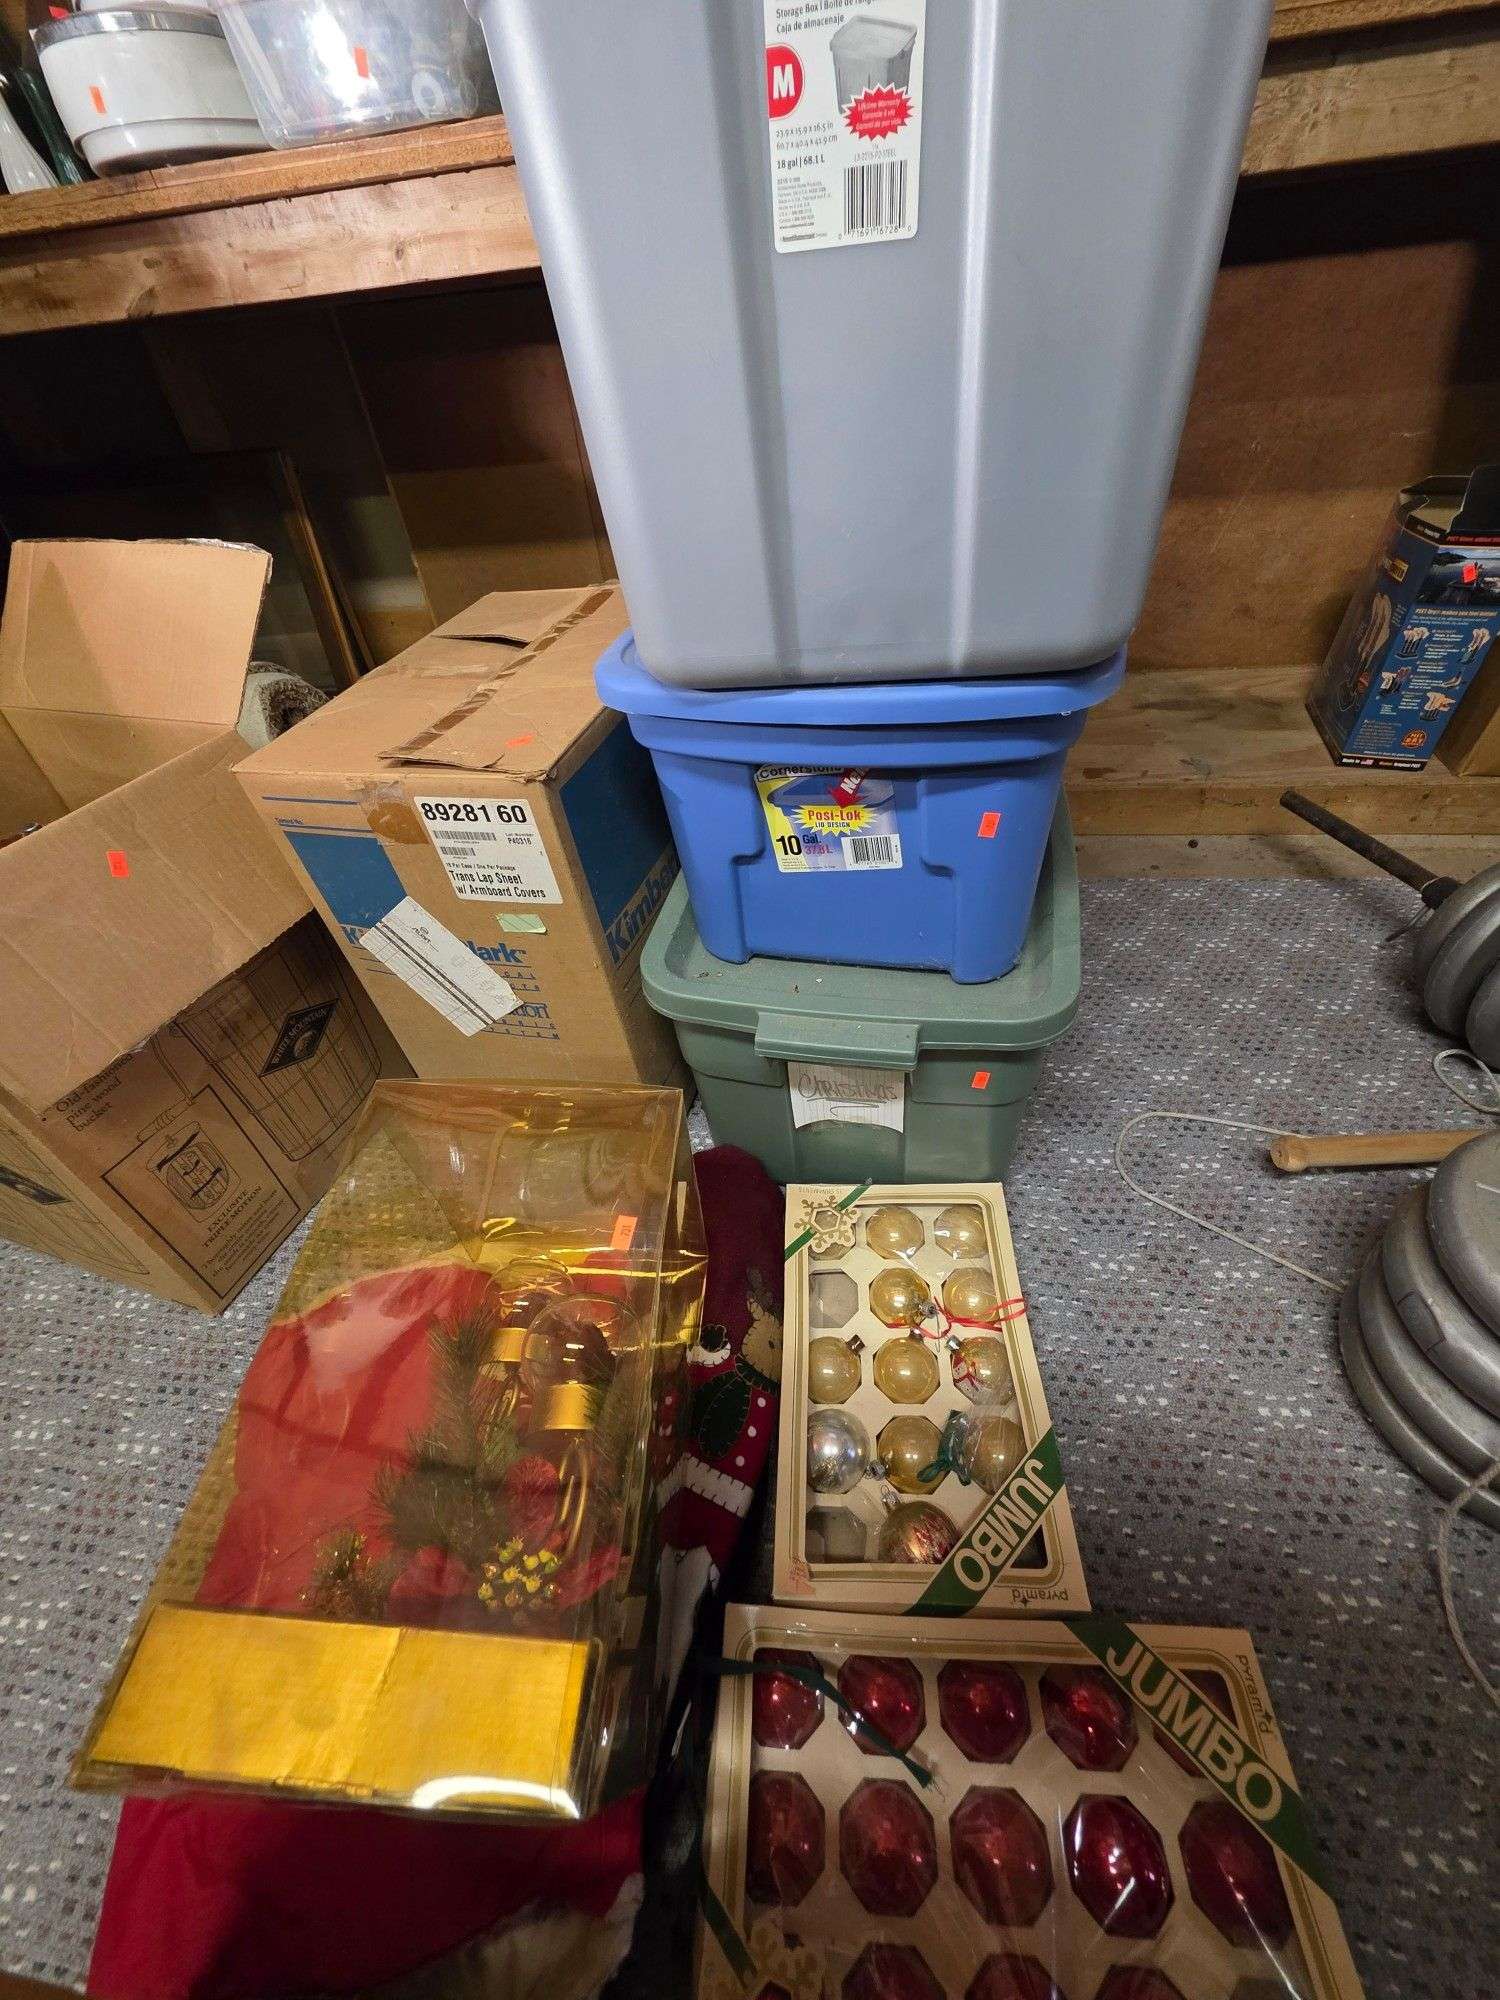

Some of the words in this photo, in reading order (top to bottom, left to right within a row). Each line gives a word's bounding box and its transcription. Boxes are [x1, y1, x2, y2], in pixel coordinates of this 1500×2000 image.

[776, 7, 803, 19] Storage
[805, 4, 819, 13] Box
[776, 23, 792, 34] Caja
[793, 22, 802, 30] de
[803, 14, 845, 29] almacenaje
[773, 64, 795, 99] M
[777, 160, 786, 169] 18
[787, 158, 798, 170] gal
[803, 155, 819, 166] 68.1
[820, 153, 826, 163] L
[808, 810, 861, 821] Posi-Lok
[776, 835, 802, 856] 10
[449, 870, 475, 882] Trans
[477, 872, 494, 884] Lap
[496, 872, 523, 885] Sheet
[456, 884, 466, 894] w/
[470, 885, 511, 897] Armboard
[514, 887, 546, 898] Covers
[66, 1102, 92, 1126] pine
[92, 1079, 122, 1102] wood
[73, 1101, 112, 1132] bucket
[954, 1458, 1055, 1592] JUMBO
[1011, 1587, 1069, 1602] pyramid
[1236, 1654, 1274, 1735] pyramid
[1106, 1641, 1282, 1822] JUMBO
